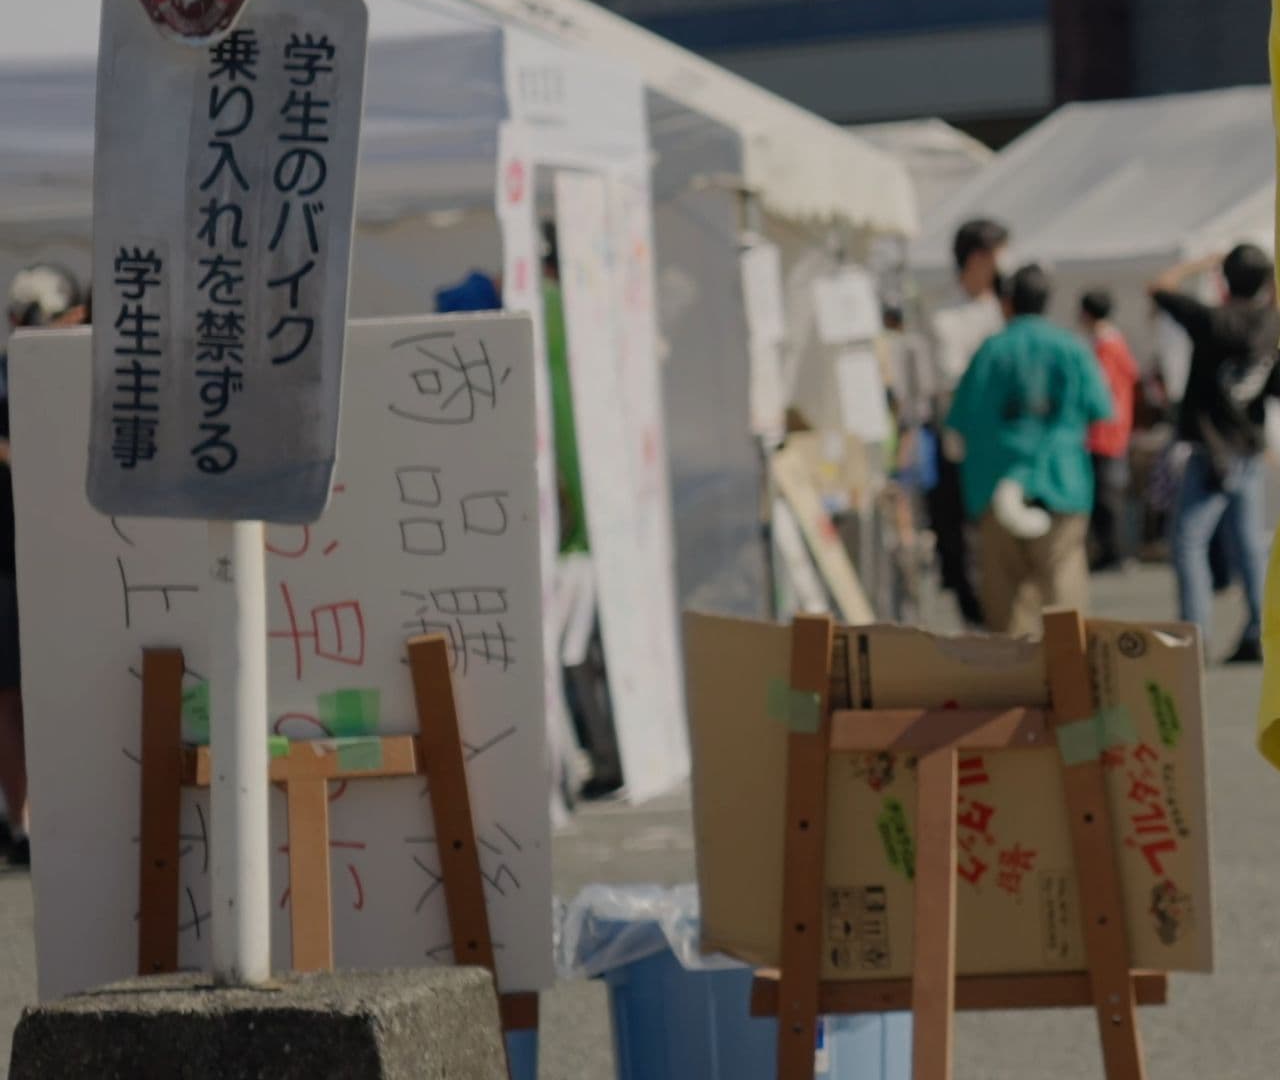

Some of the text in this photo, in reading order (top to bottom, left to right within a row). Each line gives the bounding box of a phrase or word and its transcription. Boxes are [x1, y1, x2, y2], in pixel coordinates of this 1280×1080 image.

[111, 246, 163, 469] 学生主事
[190, 28, 260, 476] 乗り入れを禁ずる
[266, 32, 336, 367] 学生のバイク
